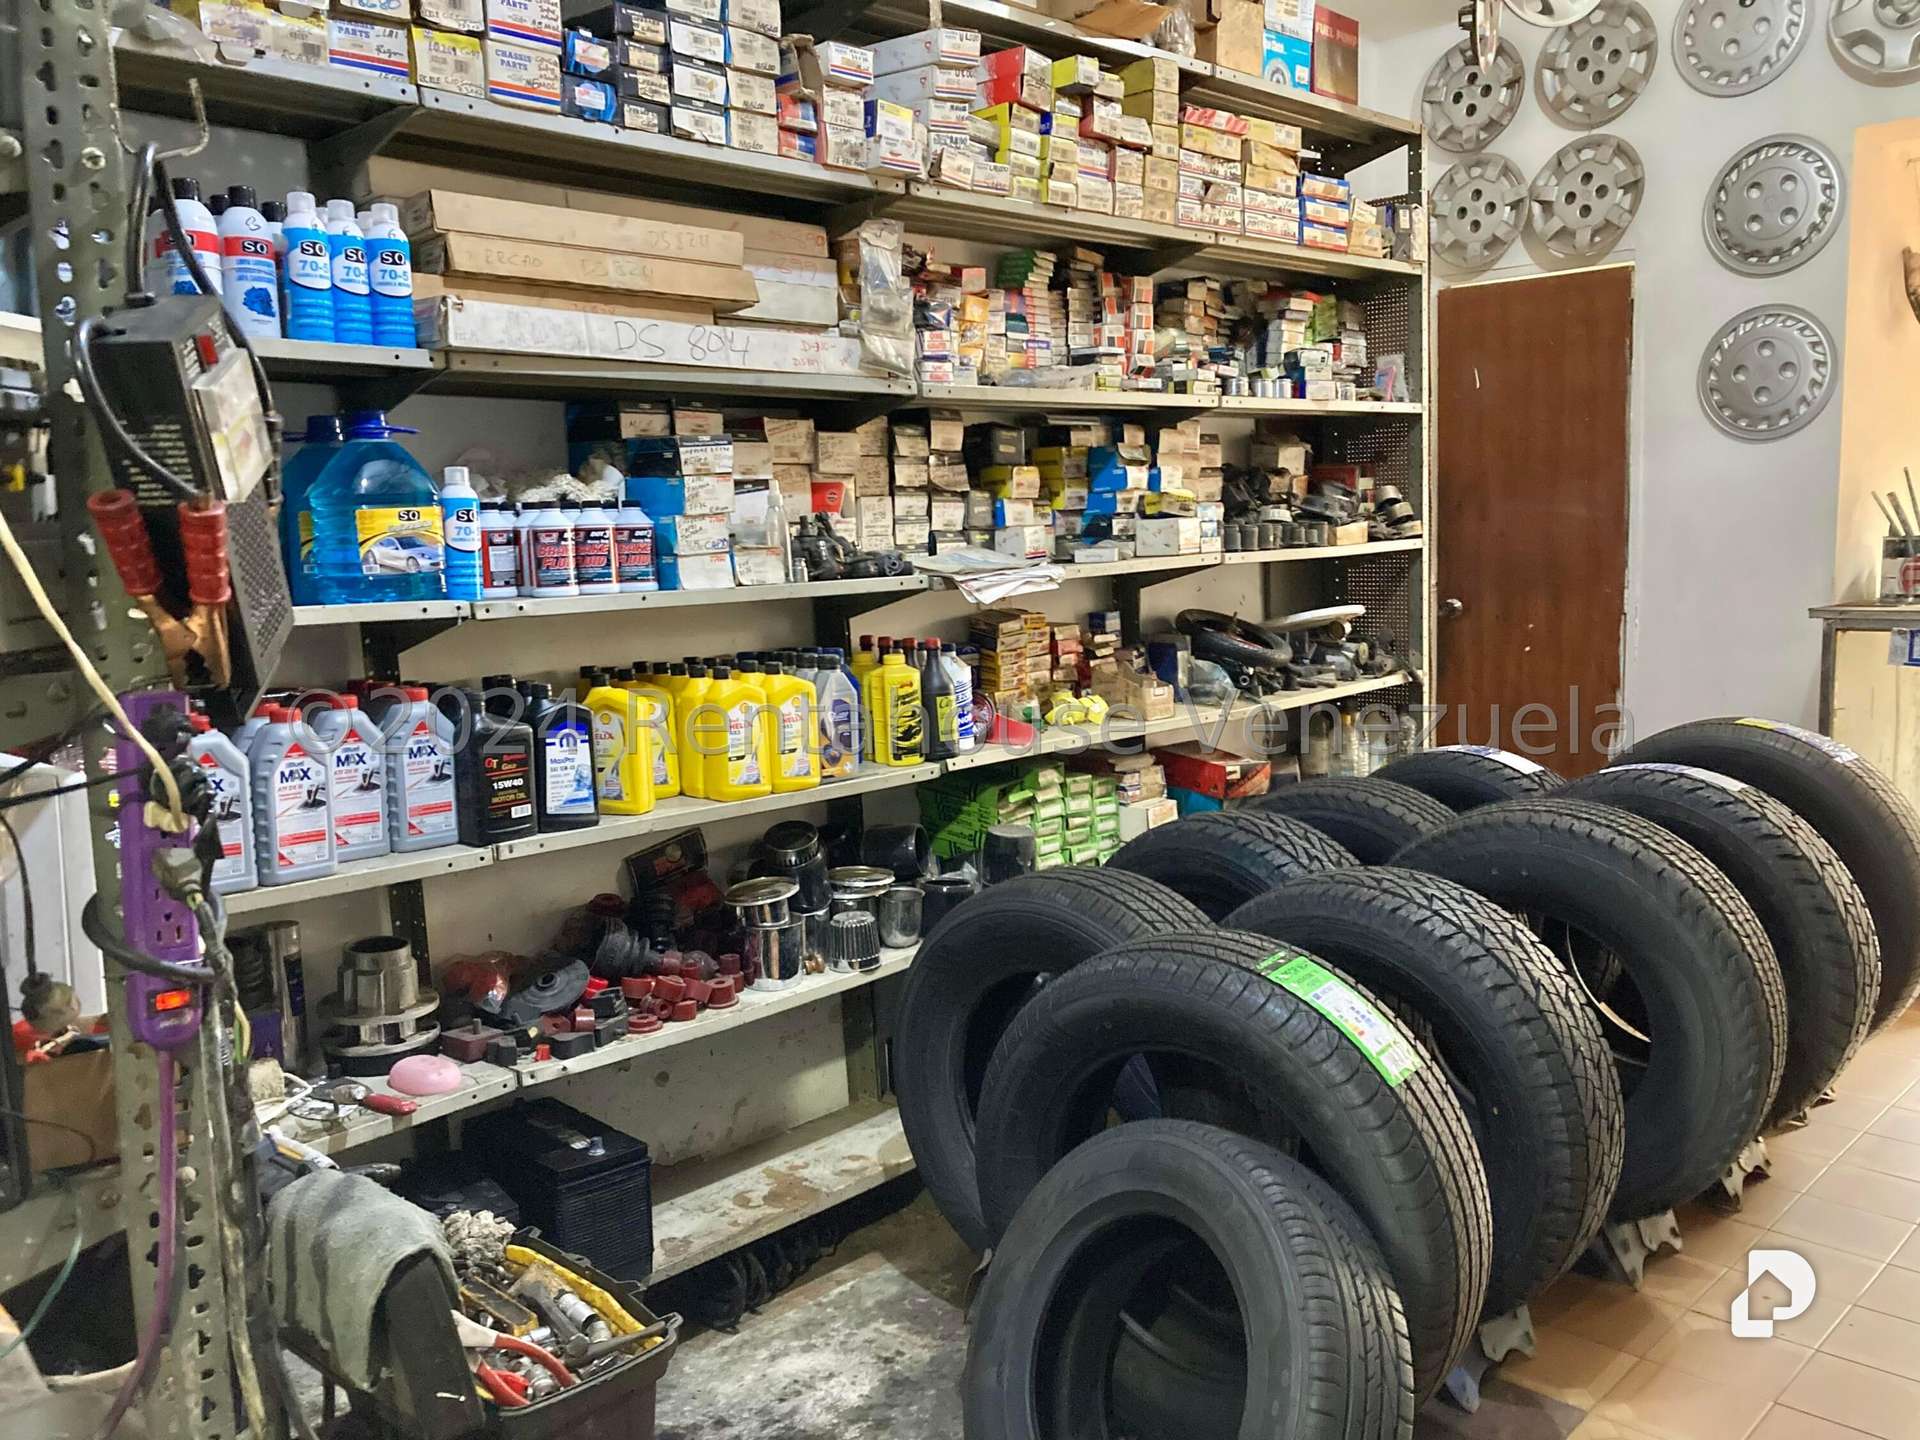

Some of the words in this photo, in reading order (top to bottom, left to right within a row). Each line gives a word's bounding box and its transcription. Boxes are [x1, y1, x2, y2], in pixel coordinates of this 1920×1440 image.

[337, 26, 371, 39] PARTS
[1315, 22, 1334, 39] FUEL
[495, 48, 532, 64] CHASSIS
[500, 59, 529, 72] PARTS
[243, 241, 267, 254] SQ
[300, 242, 326, 256] SQ
[382, 252, 406, 265] SQ
[379, 269, 409, 282] 70-5
[613, 320, 665, 360] DS
[687, 325, 750, 366] 804
[398, 510, 421, 521] SQ
[408, 744, 438, 760] MAX
[336, 751, 367, 768] MAX
[484, 757, 499, 769] GT
[279, 766, 312, 784] MAX
[492, 778, 524, 790] 15W40
